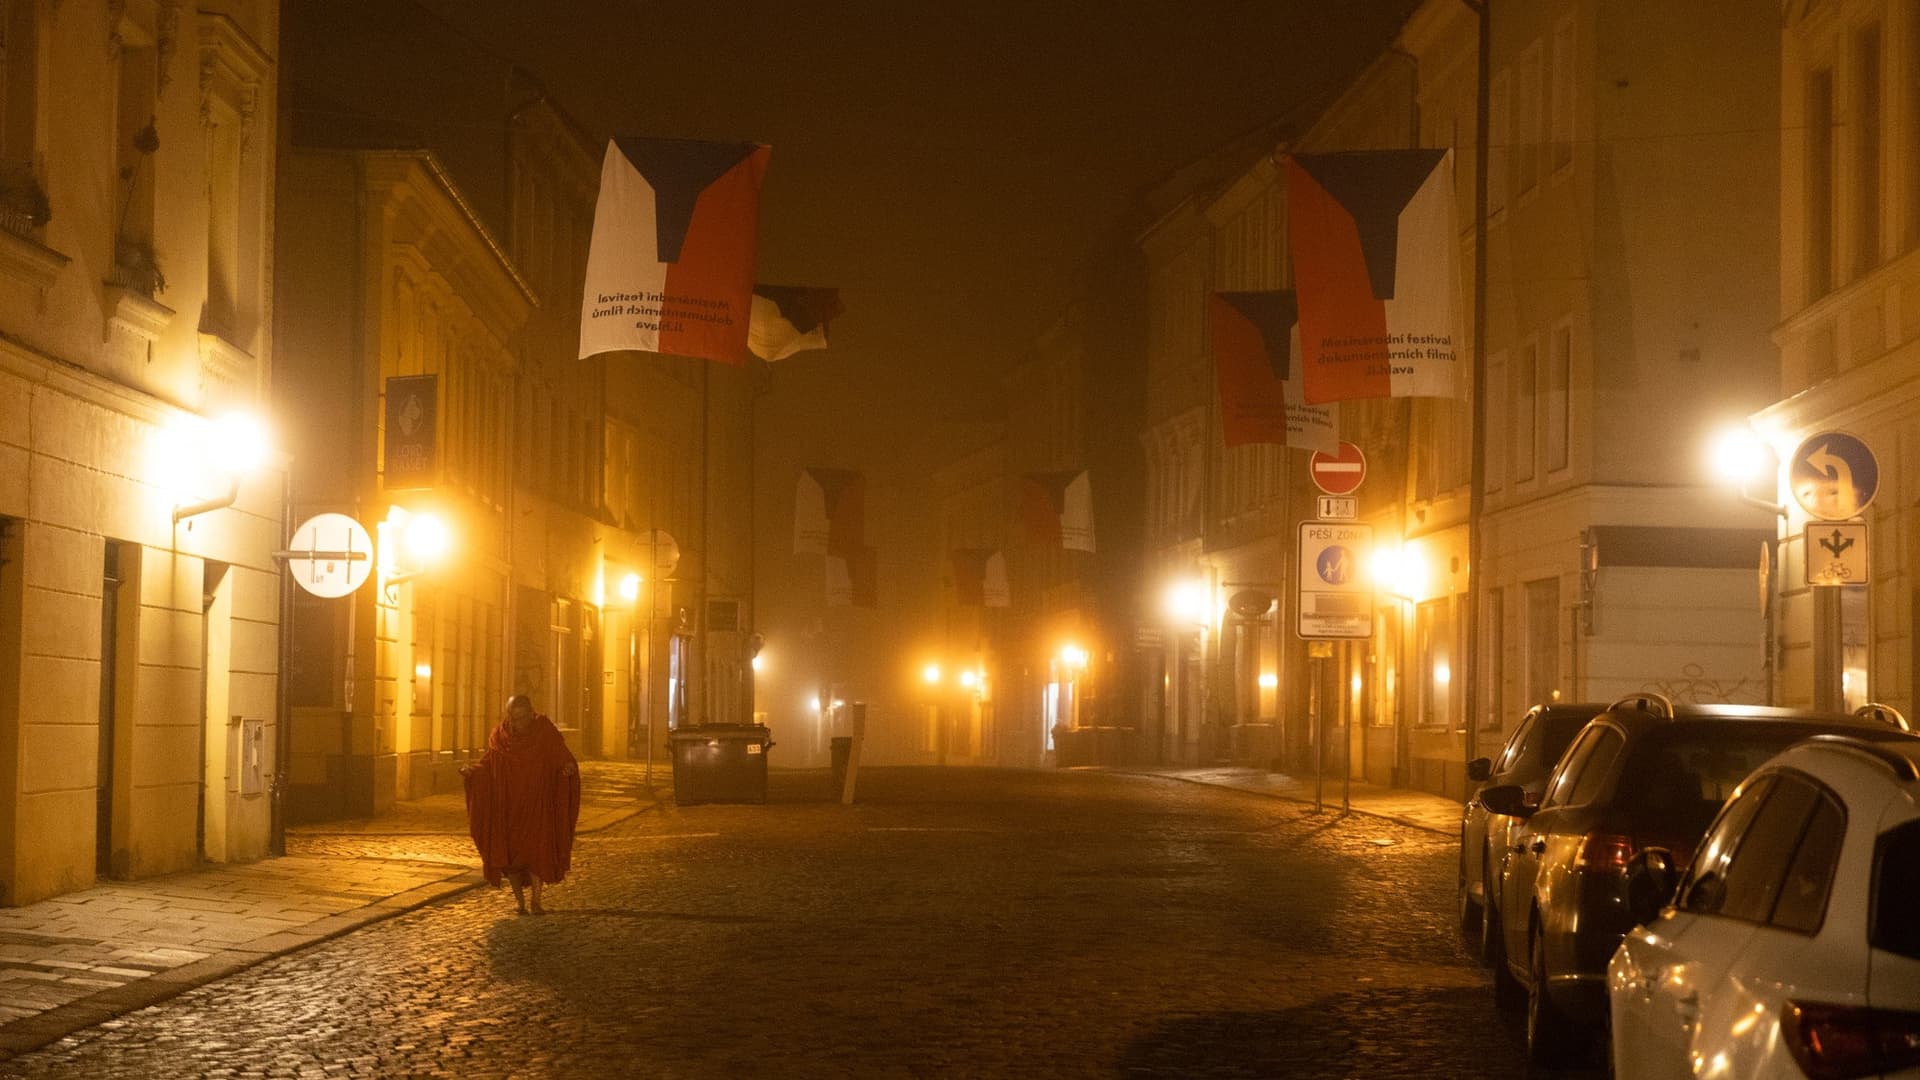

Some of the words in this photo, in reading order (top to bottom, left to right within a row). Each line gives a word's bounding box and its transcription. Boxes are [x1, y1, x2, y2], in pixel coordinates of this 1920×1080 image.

[1320, 333, 1404, 348] Mezinárodní
[1407, 333, 1452, 346] festival
[1317, 349, 1424, 365] dokumentárních
[1426, 349, 1457, 362] filmů
